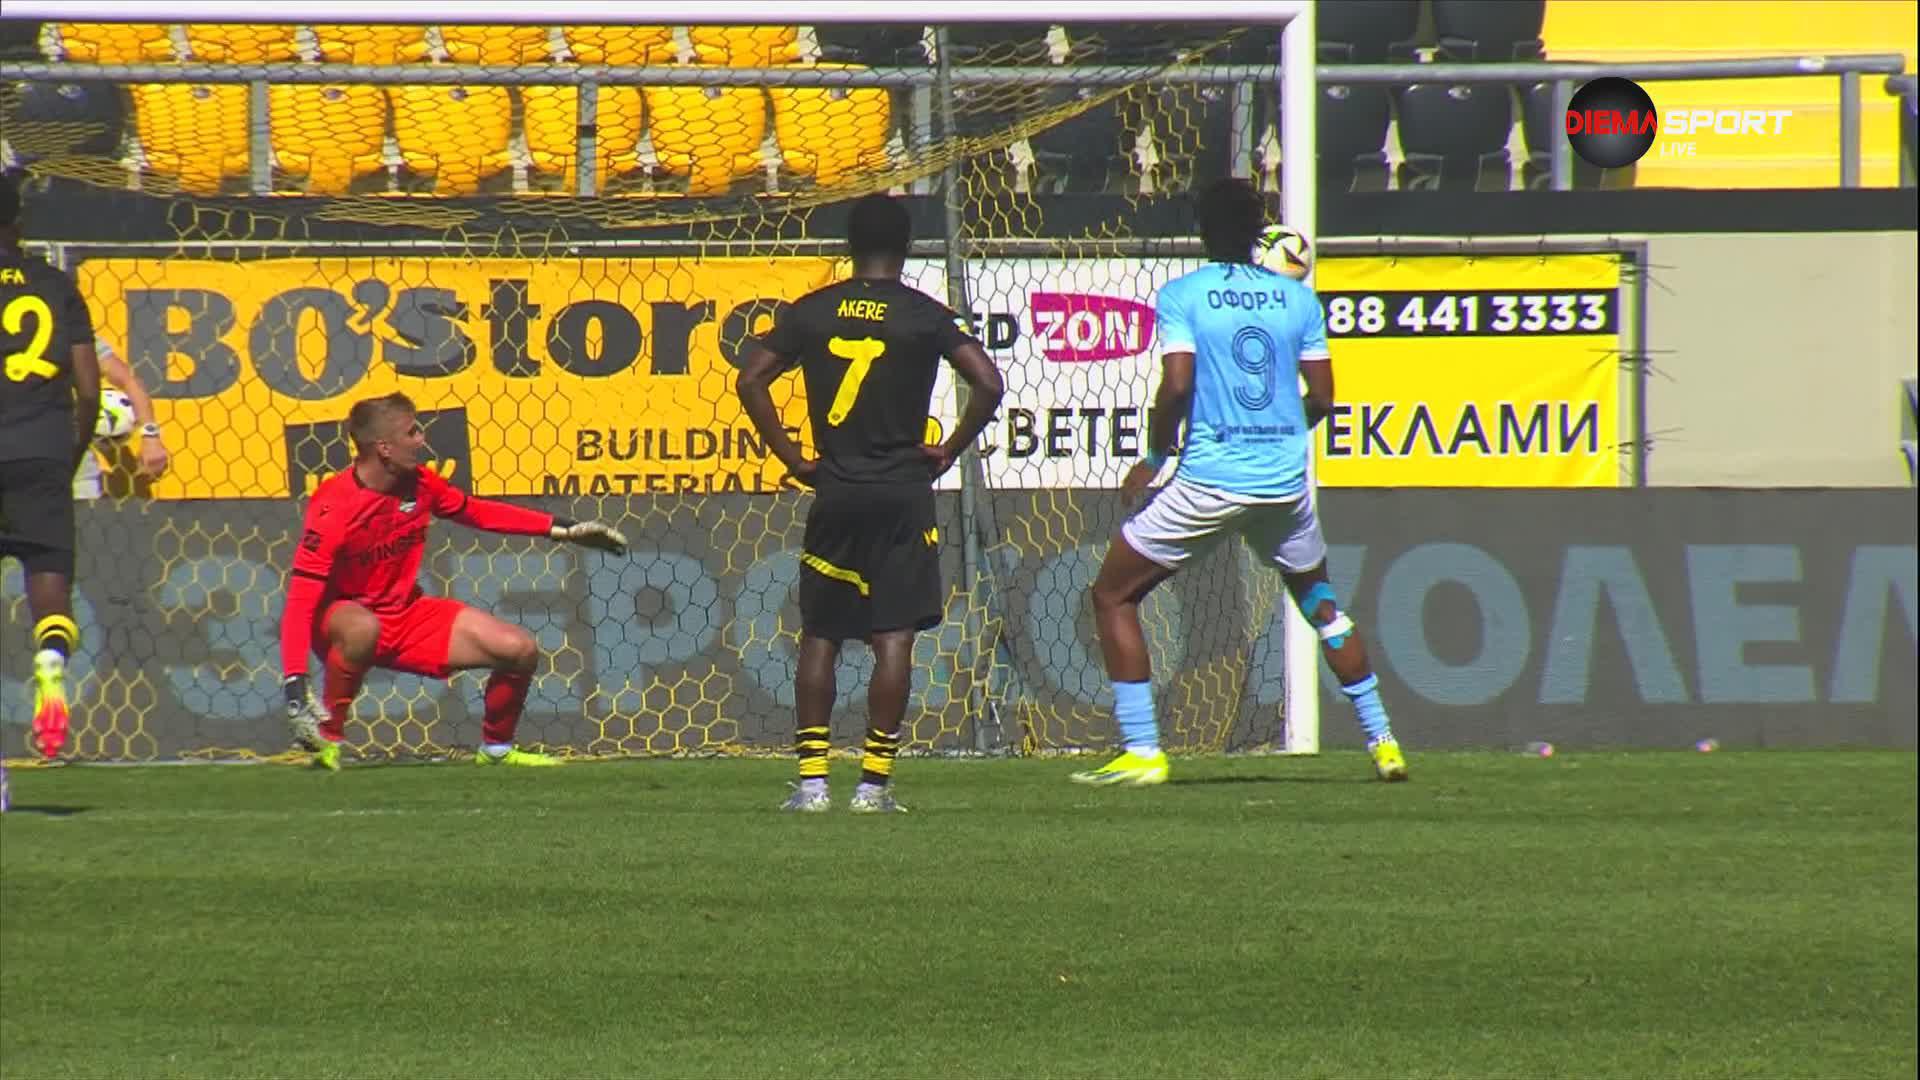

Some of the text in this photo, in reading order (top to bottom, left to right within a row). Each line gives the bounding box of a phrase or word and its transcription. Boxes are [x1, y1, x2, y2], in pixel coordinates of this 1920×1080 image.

[837, 298, 888, 321] AKERE
[1397, 295, 1479, 332] 441
[1491, 294, 1607, 331] 3333
[2, 295, 60, 382] 2
[1035, 310, 1140, 353] ZON
[828, 335, 886, 426] 7
[1231, 325, 1275, 411] 9
[576, 427, 802, 461] BUILDIN
